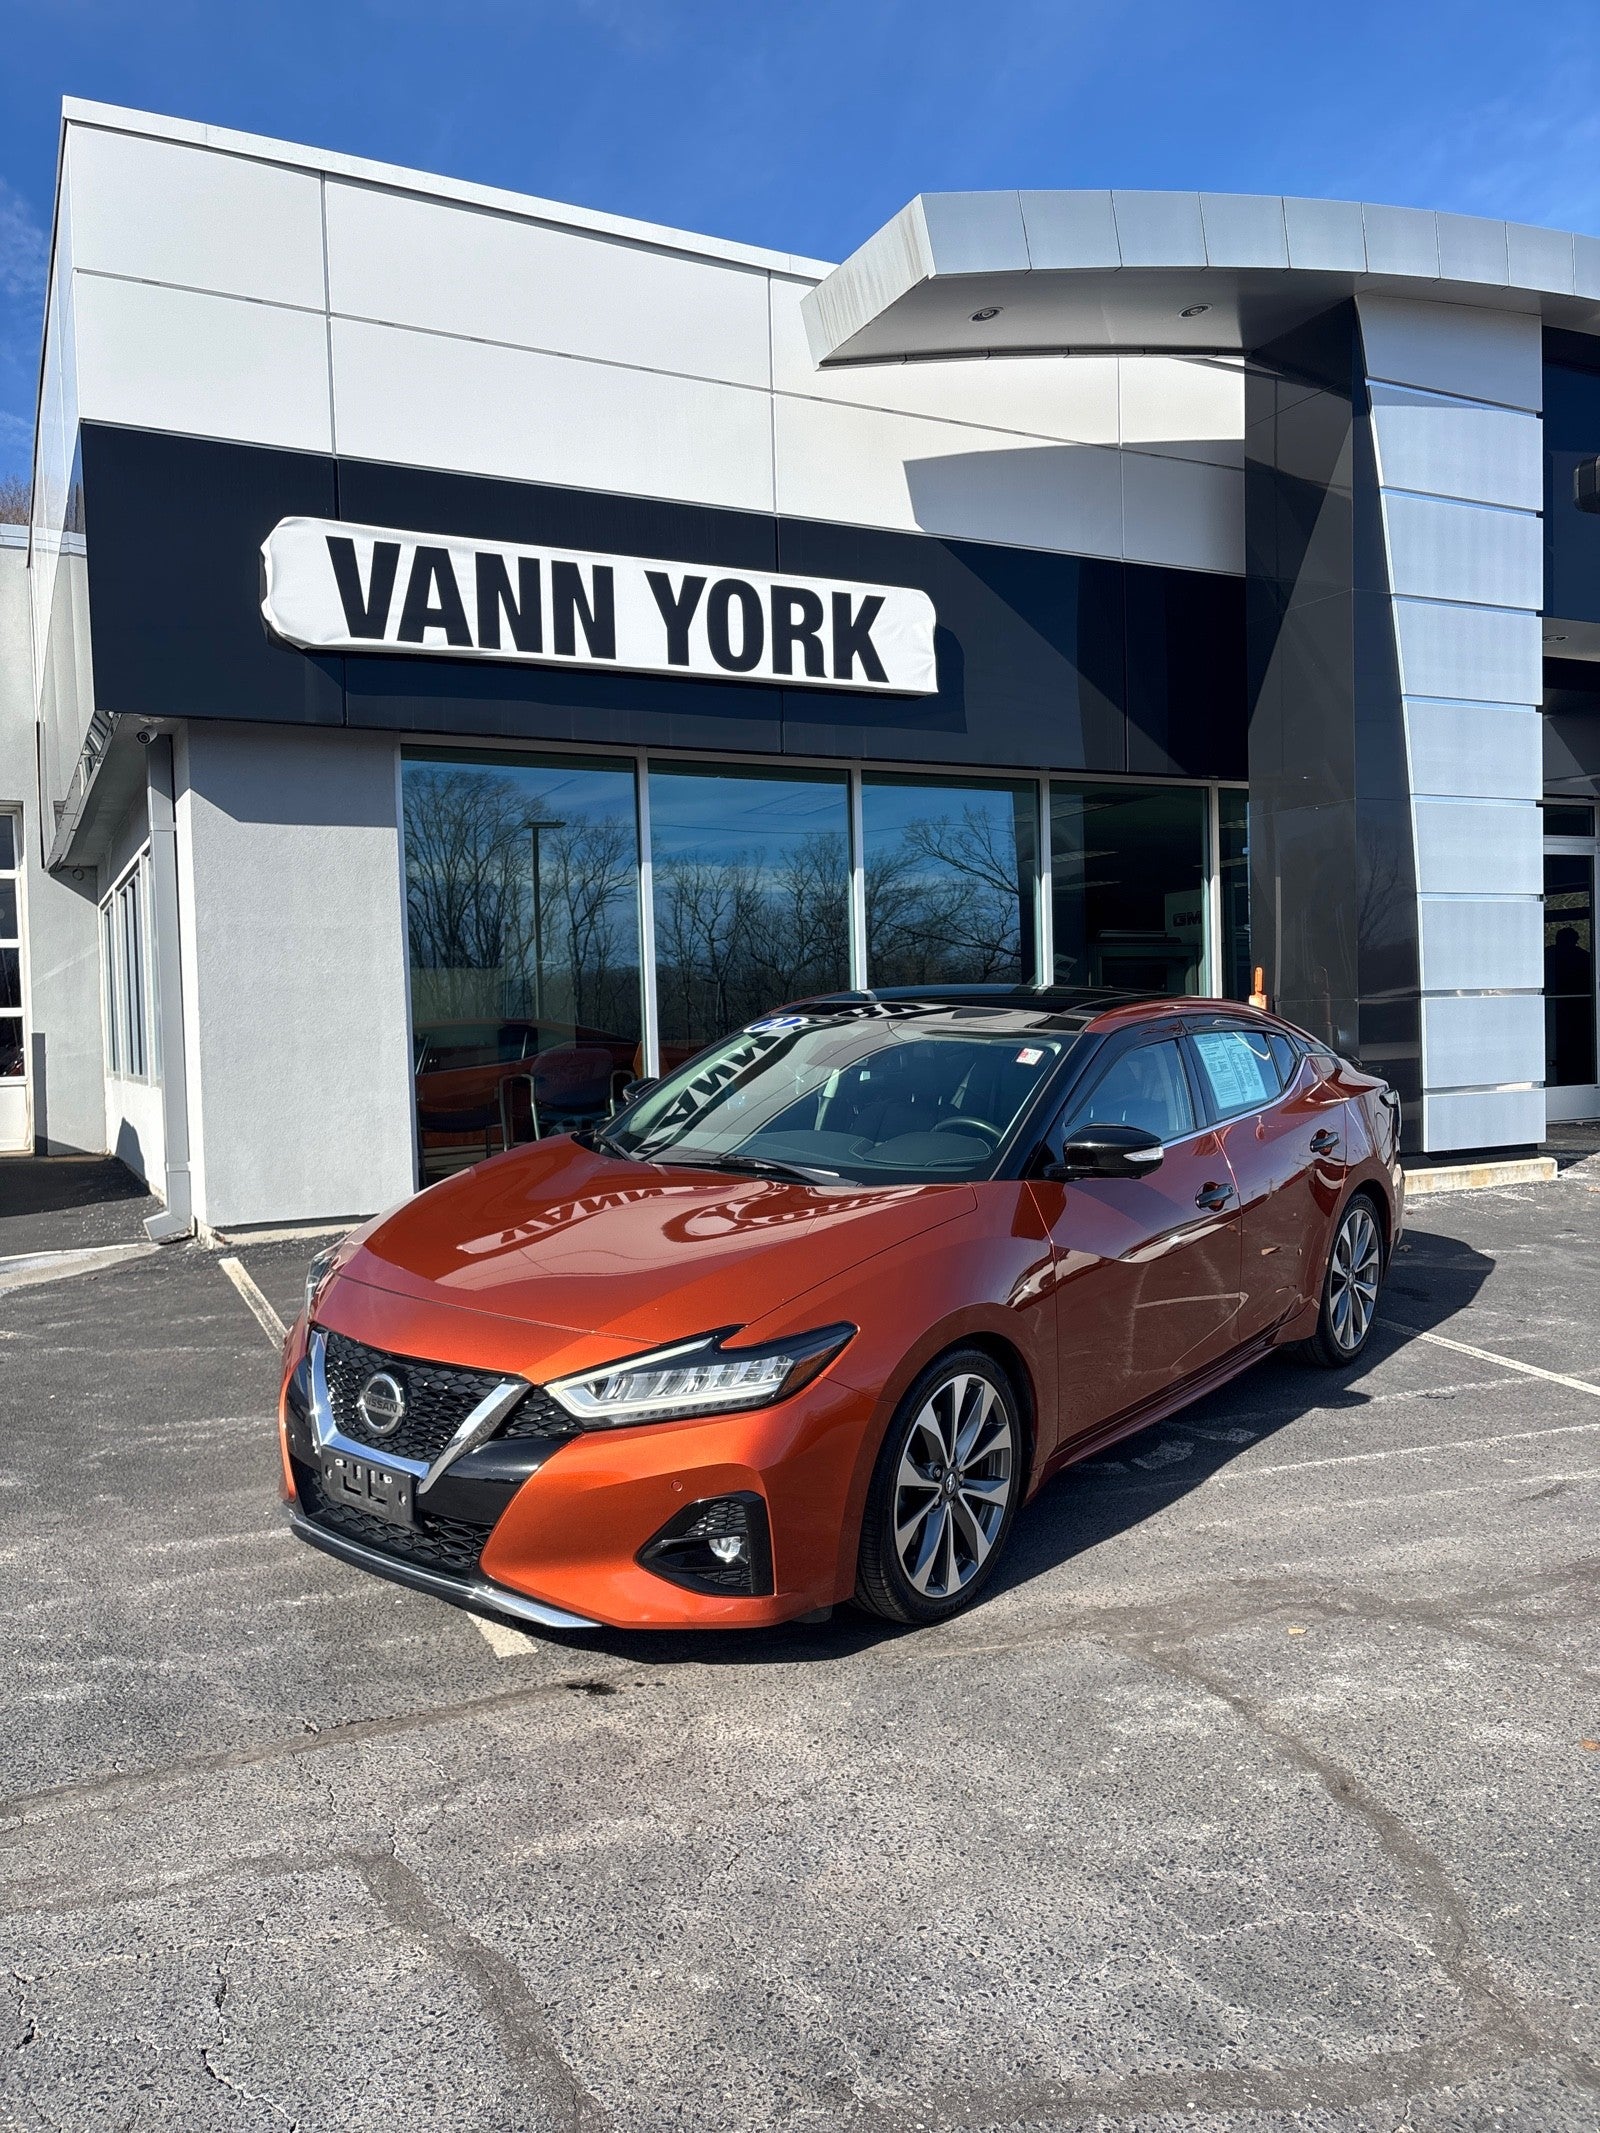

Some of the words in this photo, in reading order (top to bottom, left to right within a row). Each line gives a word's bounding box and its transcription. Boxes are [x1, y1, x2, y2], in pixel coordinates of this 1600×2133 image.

[325, 535, 616, 660] VANN
[643, 571, 889, 683] YORK
[363, 1394, 398, 1413] NISSAN
